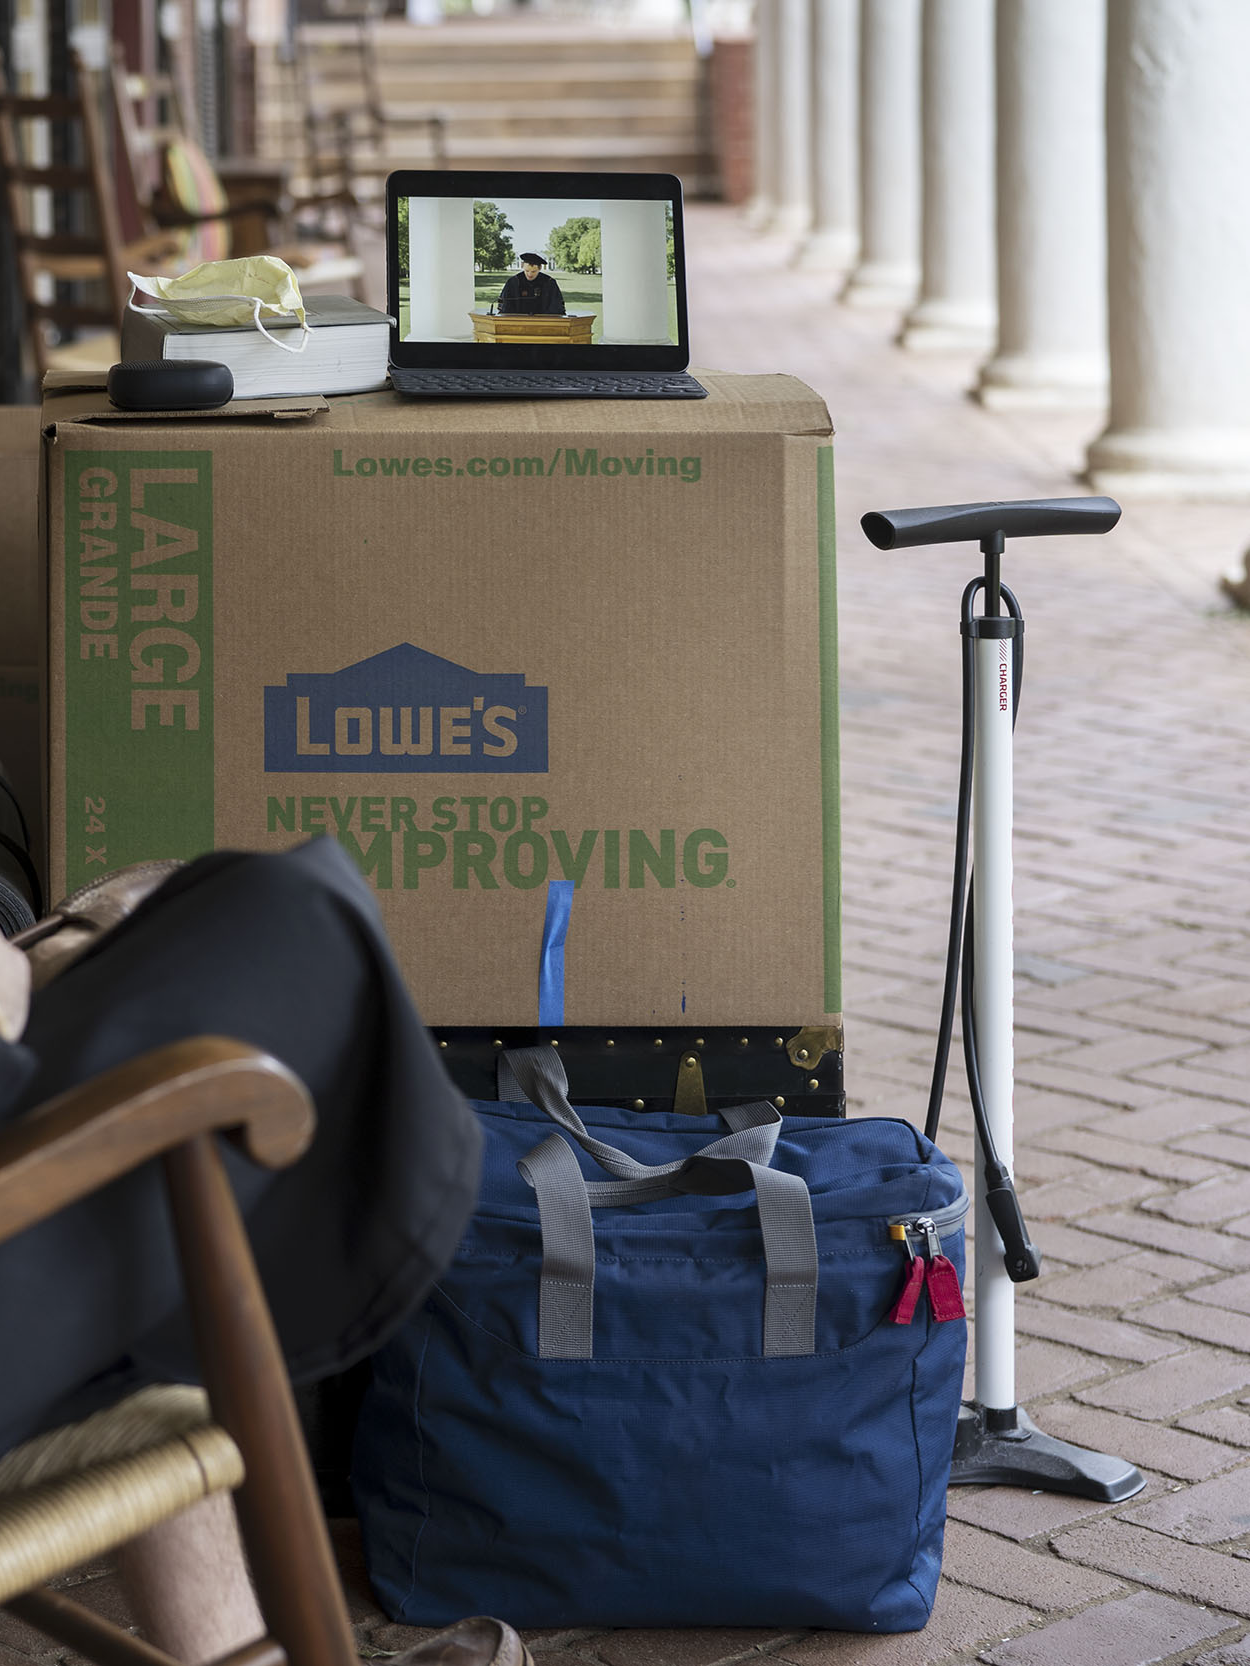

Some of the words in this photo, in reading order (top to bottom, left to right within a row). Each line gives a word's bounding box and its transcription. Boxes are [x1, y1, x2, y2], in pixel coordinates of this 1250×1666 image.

[333, 448, 702, 483] Lowes.com/Moving
[78, 467, 118, 660] GRANDE
[129, 468, 200, 730] LARGE
[998, 662, 1008, 712] CHARGER
[296, 696, 518, 757] LOWE'S
[85, 799, 105, 834] 24
[266, 796, 418, 832] NEVER
[430, 796, 549, 833] STOP
[311, 828, 729, 890] MPROVING
